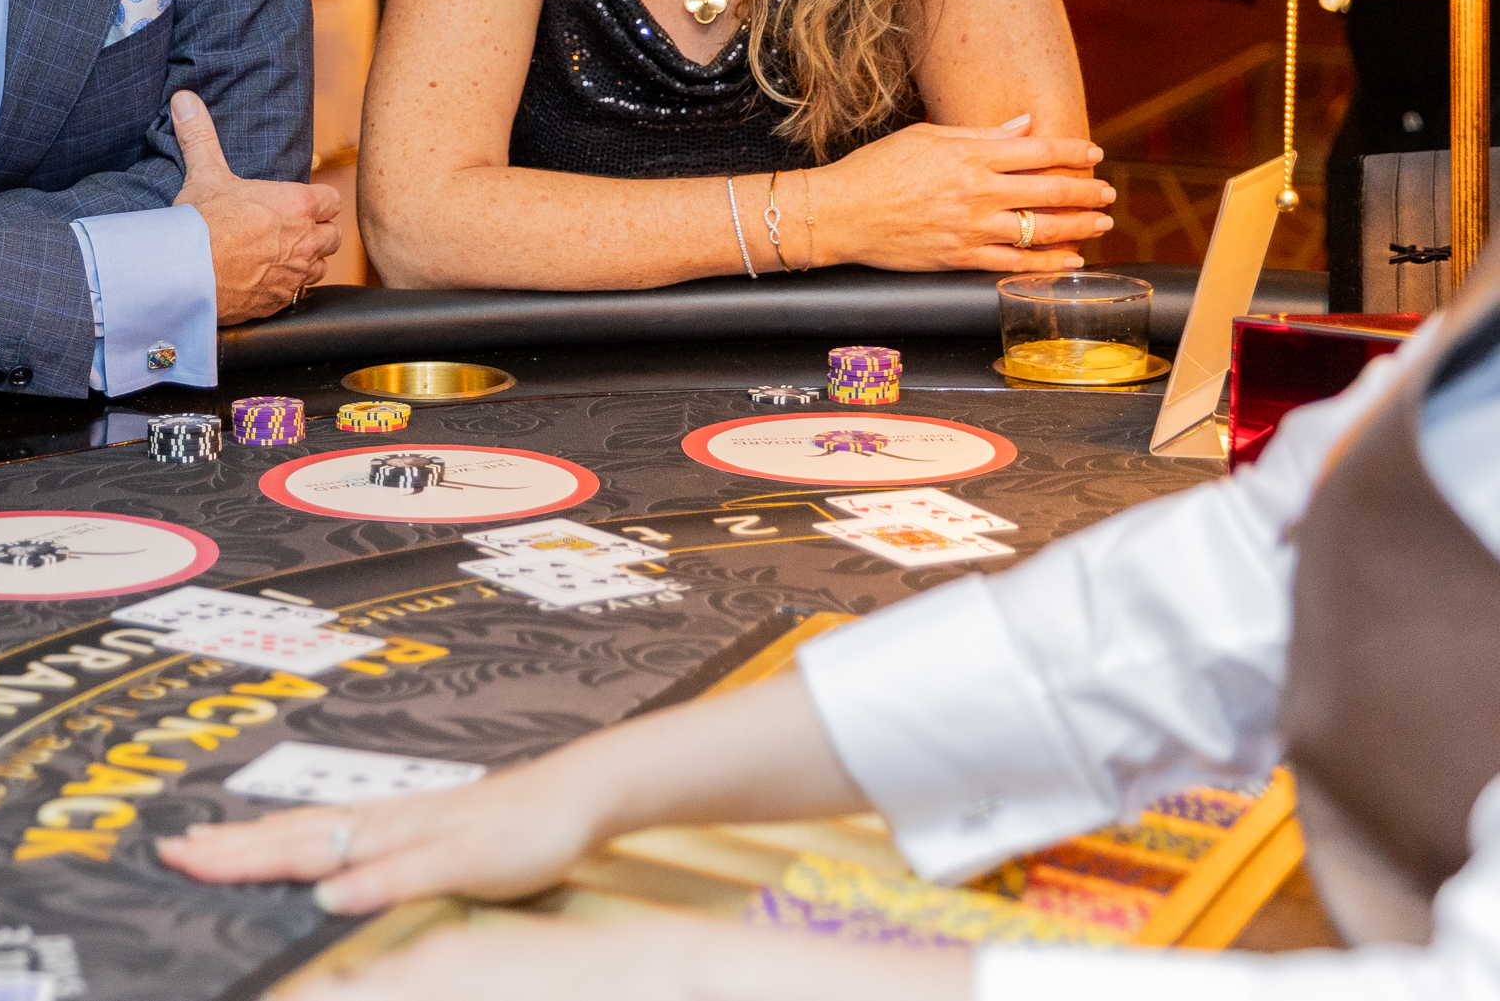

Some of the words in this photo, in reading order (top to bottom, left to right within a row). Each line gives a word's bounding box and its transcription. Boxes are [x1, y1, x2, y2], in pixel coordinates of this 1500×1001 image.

[834, 498, 857, 508] 7
[713, 514, 779, 536] 2
[827, 524, 847, 535] J
[984, 518, 1008, 530] 7
[621, 525, 673, 542] t
[976, 542, 998, 553] J
[579, 590, 685, 614] pays
[63, 704, 139, 734] 16
